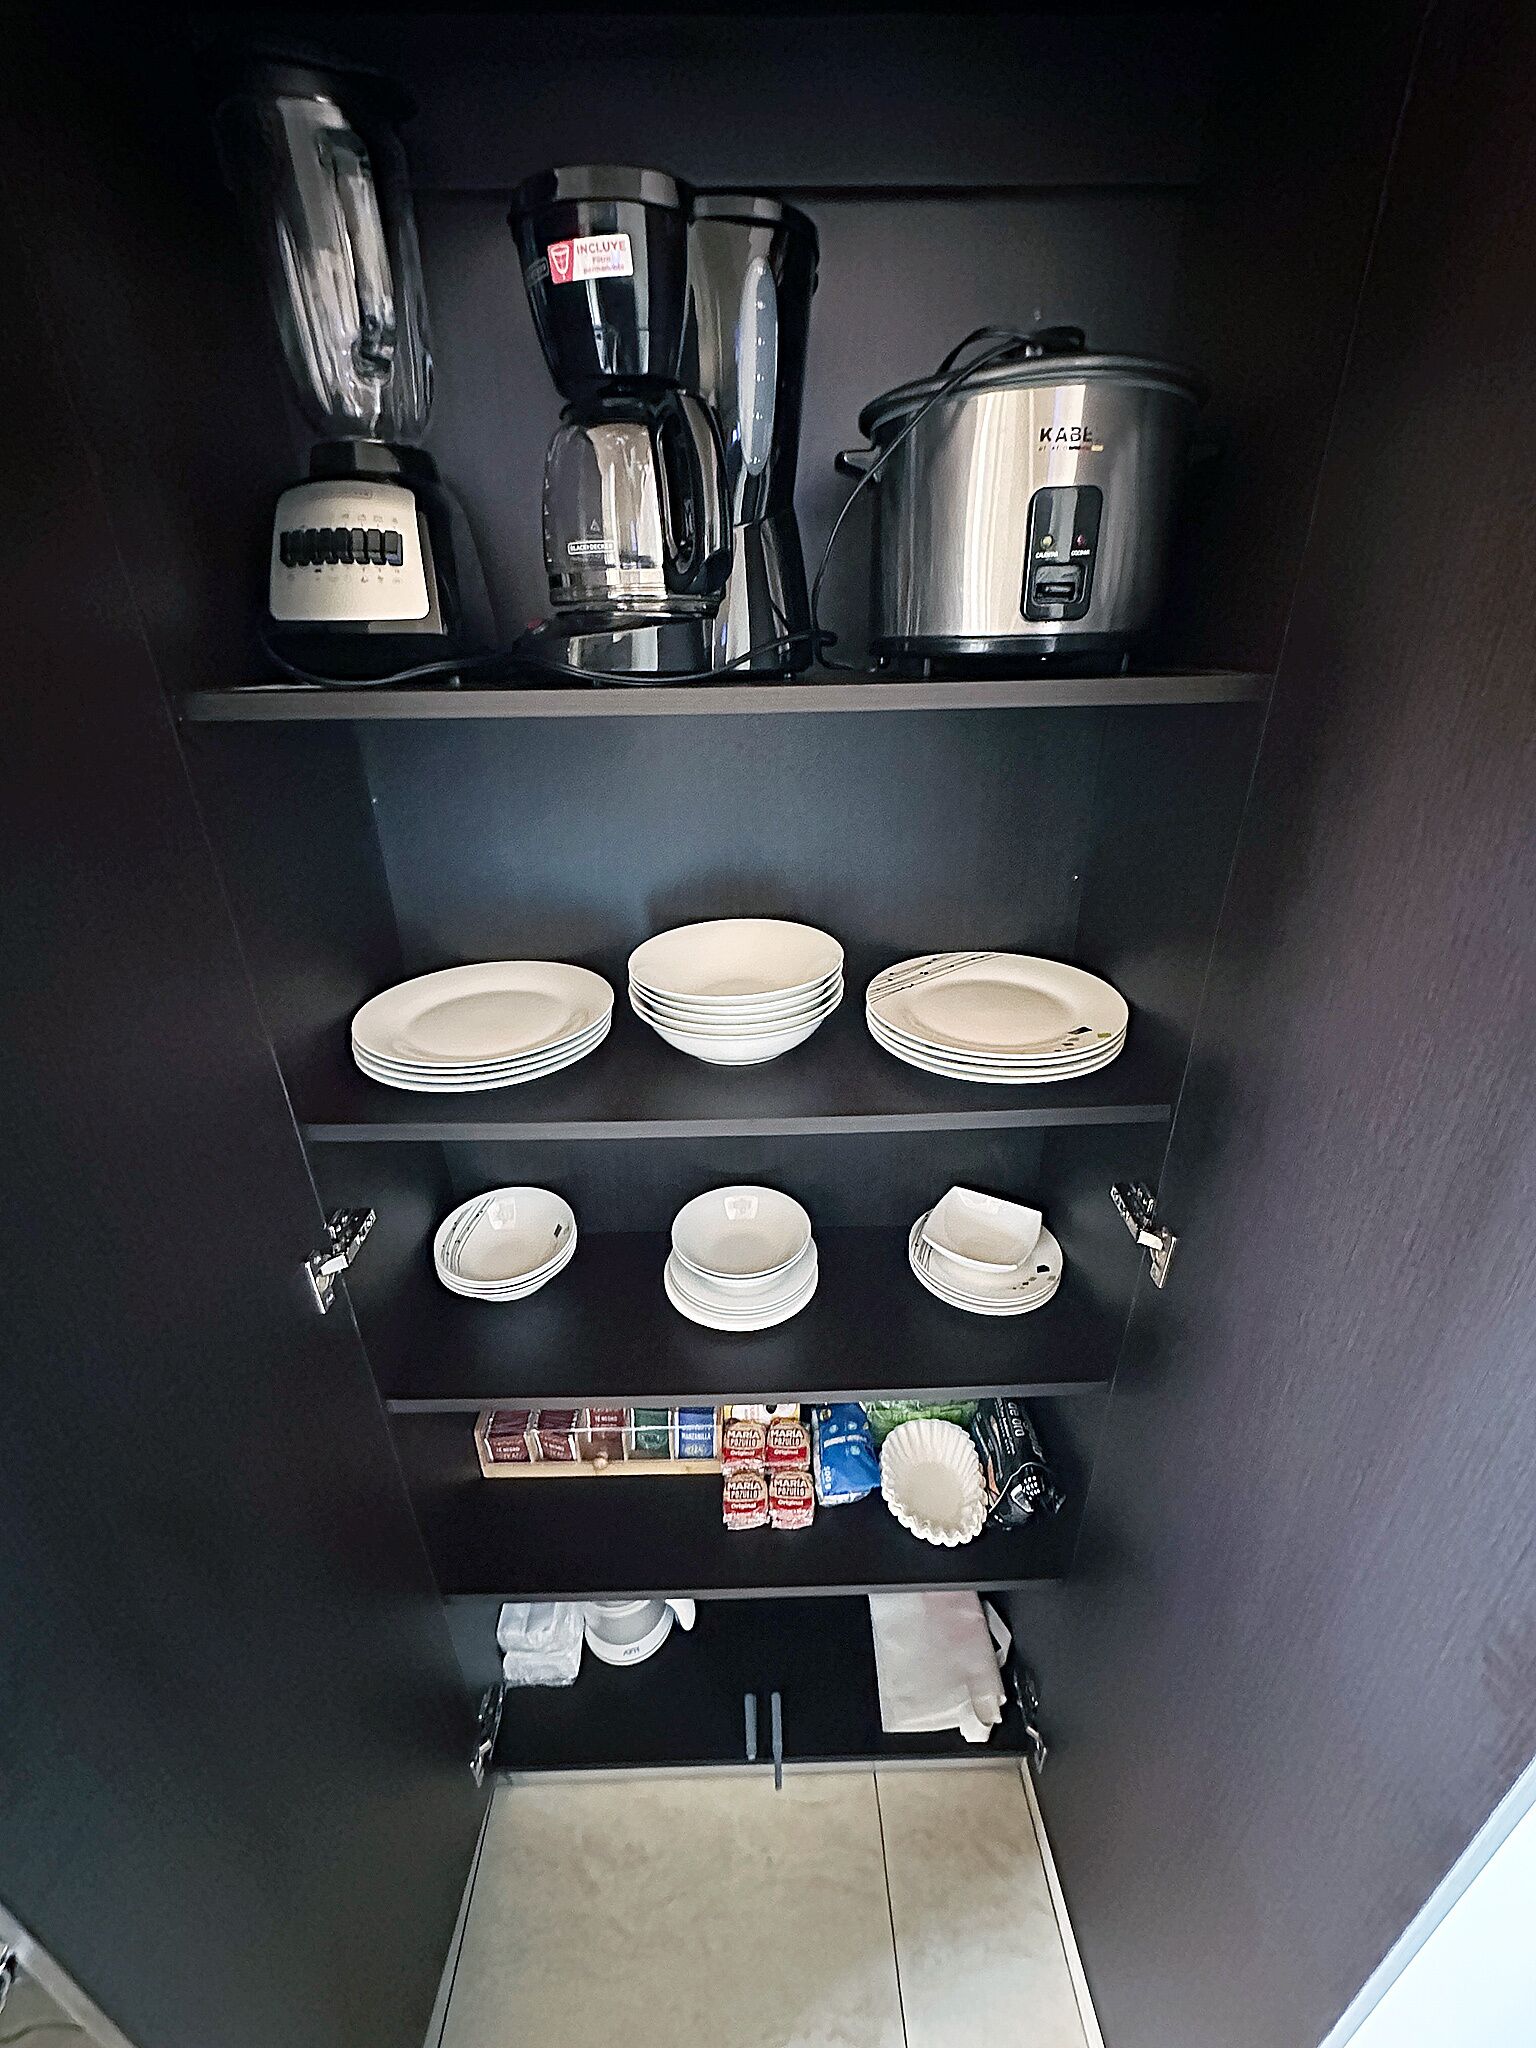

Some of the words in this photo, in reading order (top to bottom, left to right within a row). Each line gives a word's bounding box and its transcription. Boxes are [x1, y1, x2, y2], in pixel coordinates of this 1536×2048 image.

[576, 240, 626, 254] INCLUYE
[730, 1449, 755, 1457] Original
[731, 1501, 757, 1509] Original
